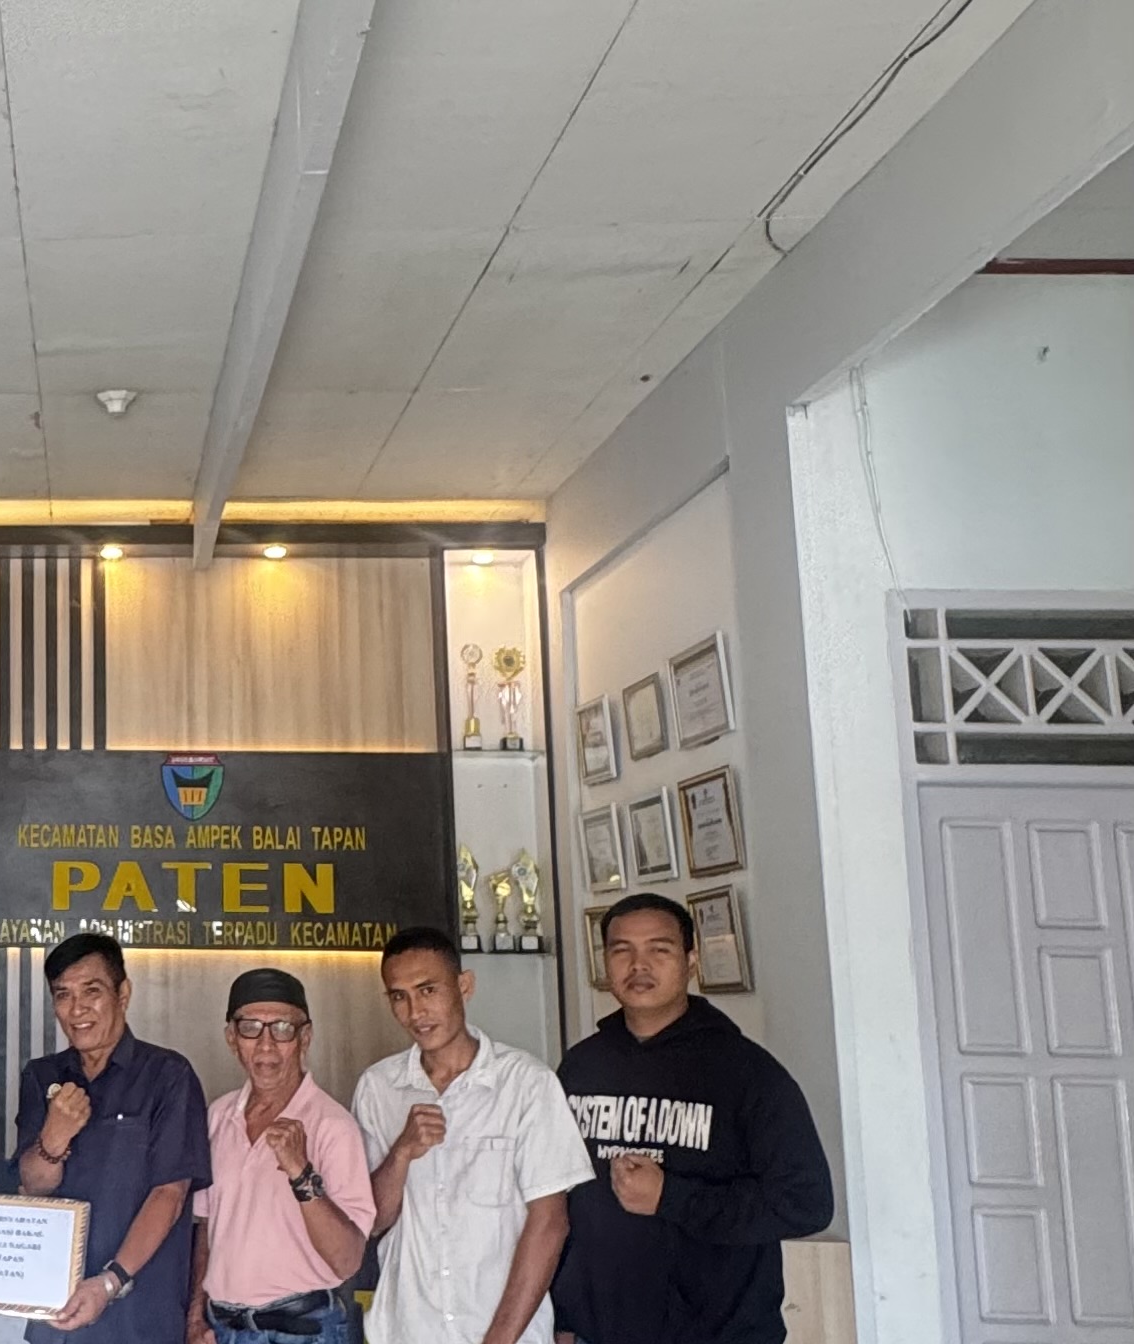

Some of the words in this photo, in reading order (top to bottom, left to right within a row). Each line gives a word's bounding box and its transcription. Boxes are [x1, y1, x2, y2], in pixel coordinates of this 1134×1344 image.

[18, 824, 119, 848] KECAMATAN
[130, 824, 176, 849] BASA
[185, 825, 243, 850] AMPEK
[252, 826, 301, 850] BALAI
[312, 827, 366, 851] TAPAN
[51, 860, 335, 913] PATEN
[202, 921, 278, 945] TERPADU
[290, 922, 397, 946] KECAMATAN
[623, 1096, 648, 1142] OF
[645, 1097, 657, 1142] A
[657, 1099, 713, 1151] DOWN
